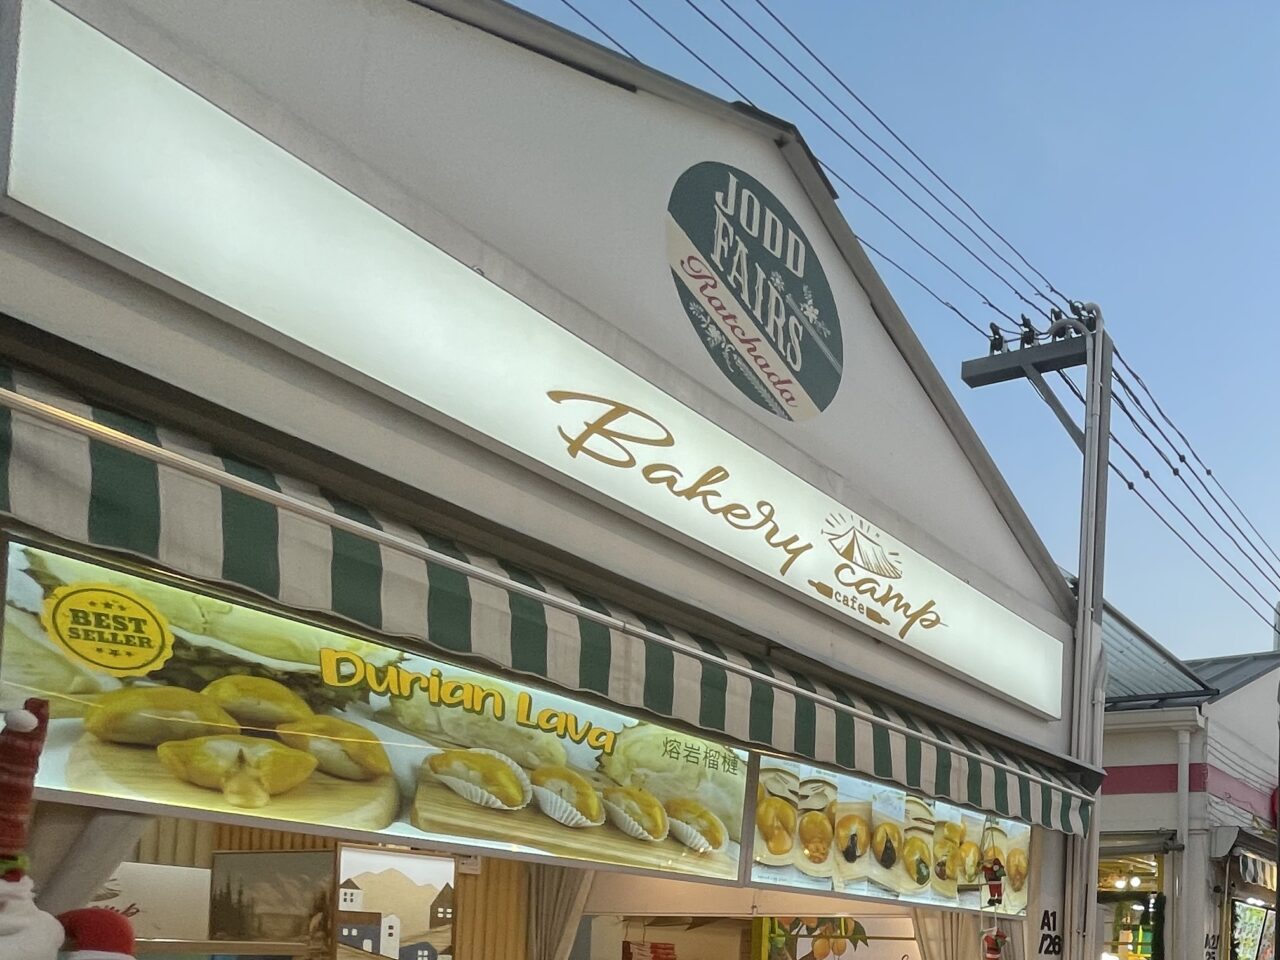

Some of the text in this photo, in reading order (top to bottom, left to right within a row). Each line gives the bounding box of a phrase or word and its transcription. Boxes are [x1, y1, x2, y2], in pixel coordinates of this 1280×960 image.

[715, 172, 806, 278] JODD
[680, 254, 799, 408] Ratchada
[710, 205, 803, 372] FAIRS
[546, 390, 950, 640] Bakery camp
[68, 627, 154, 648] SELLER
[69, 608, 147, 634] BEST
[834, 588, 866, 617] cafe
[319, 647, 618, 754] Durian Lava
[1040, 910, 1056, 931] A1
